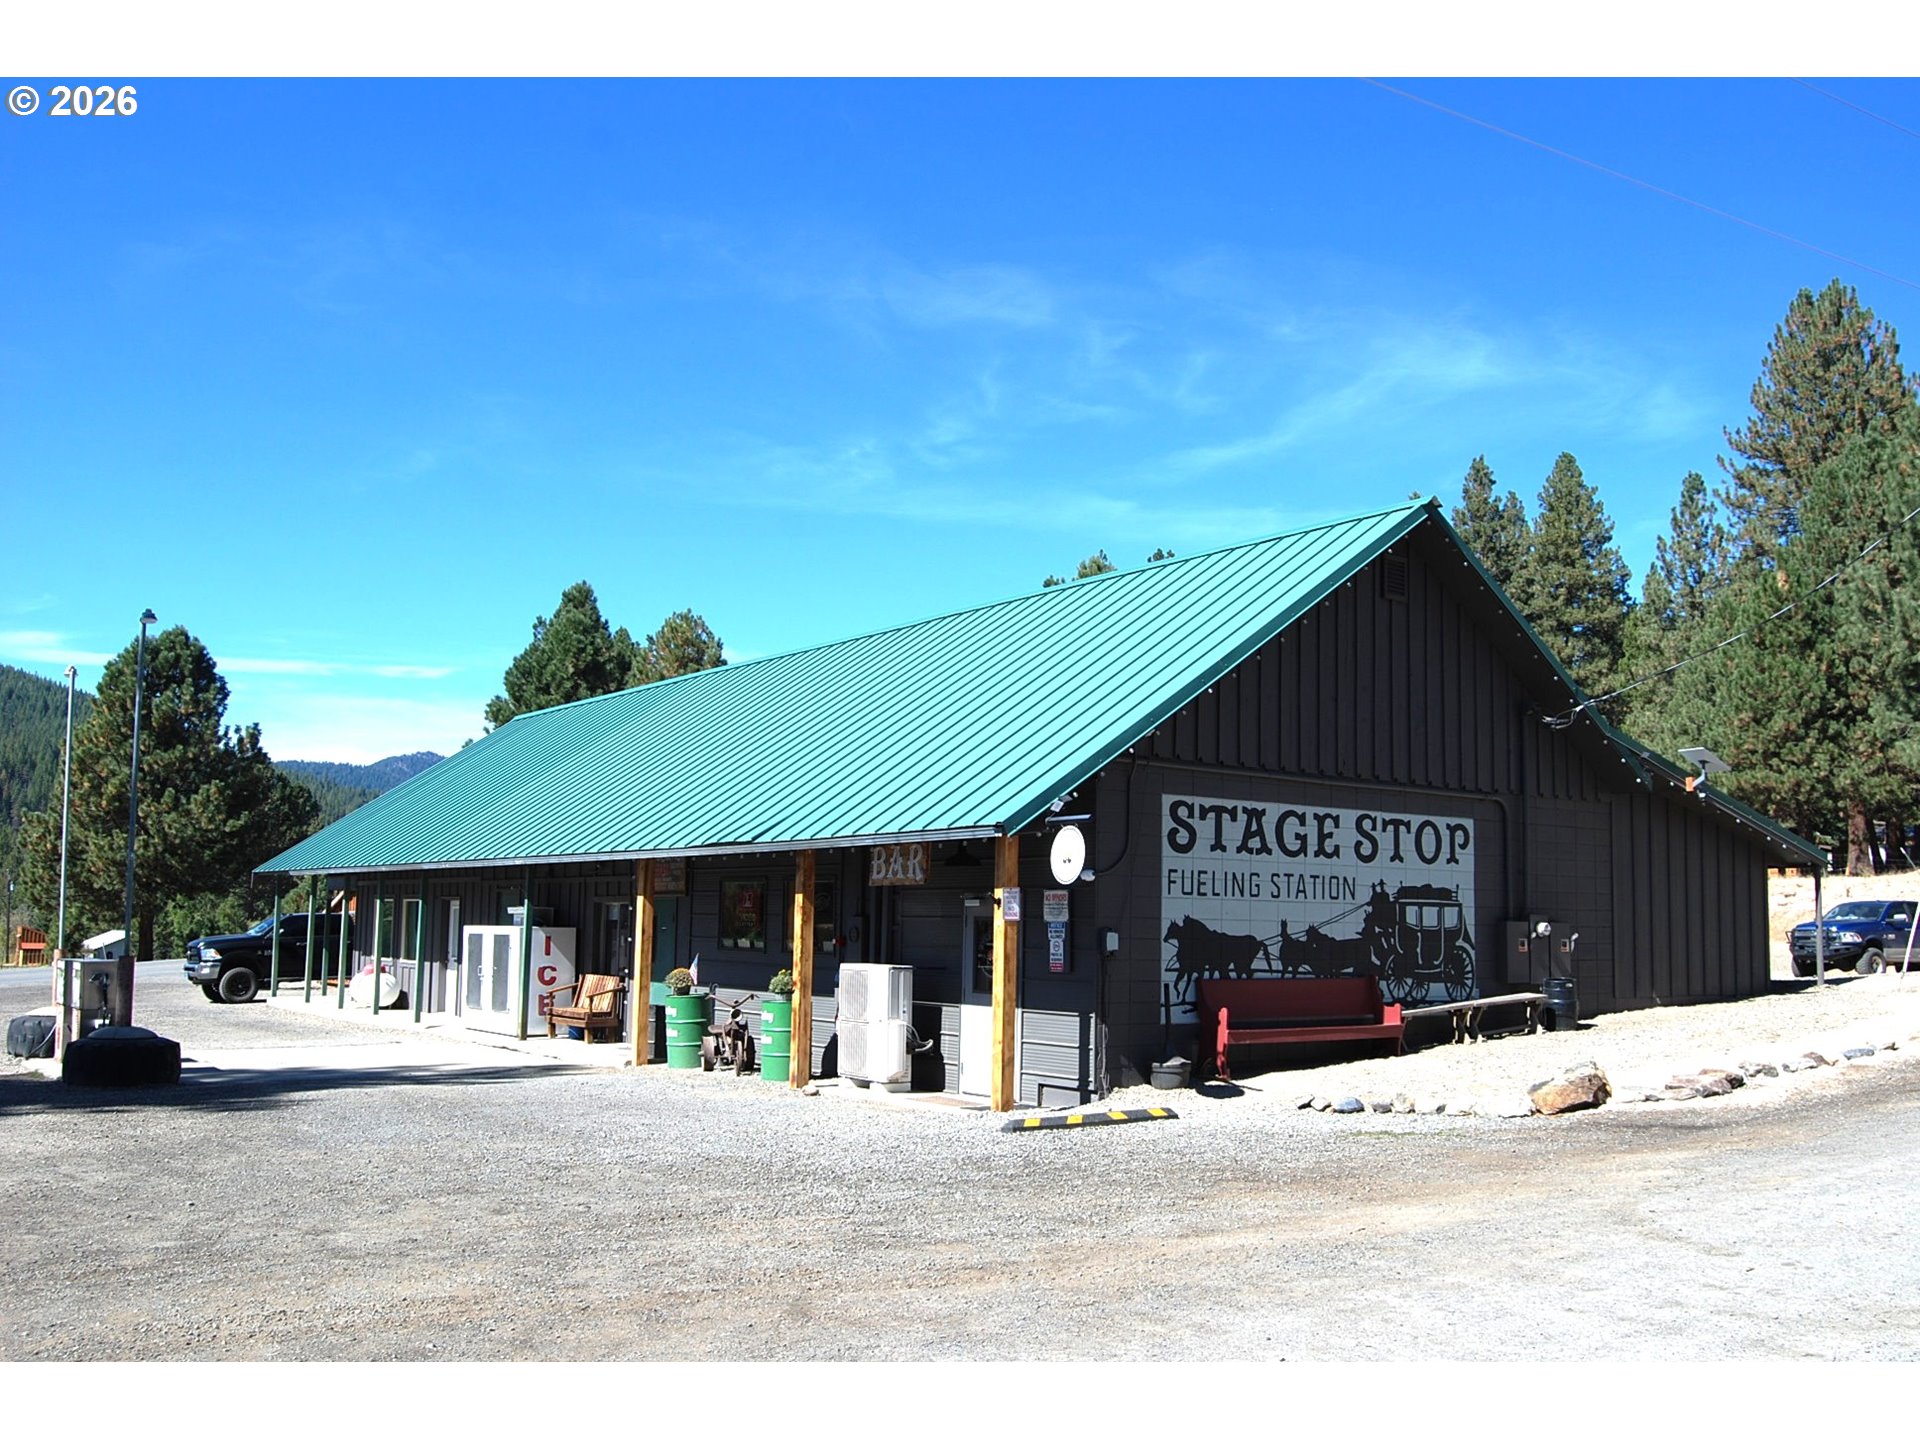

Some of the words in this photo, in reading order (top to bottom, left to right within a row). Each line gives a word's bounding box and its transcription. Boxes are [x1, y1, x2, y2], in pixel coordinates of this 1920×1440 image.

[1167, 799, 1341, 860] STAGE
[1353, 812, 1471, 865] STOP
[870, 843, 924, 881] BAR
[1167, 868, 1261, 899] FUELING
[1270, 872, 1356, 901] STATION
[537, 935, 558, 1017] ICE
